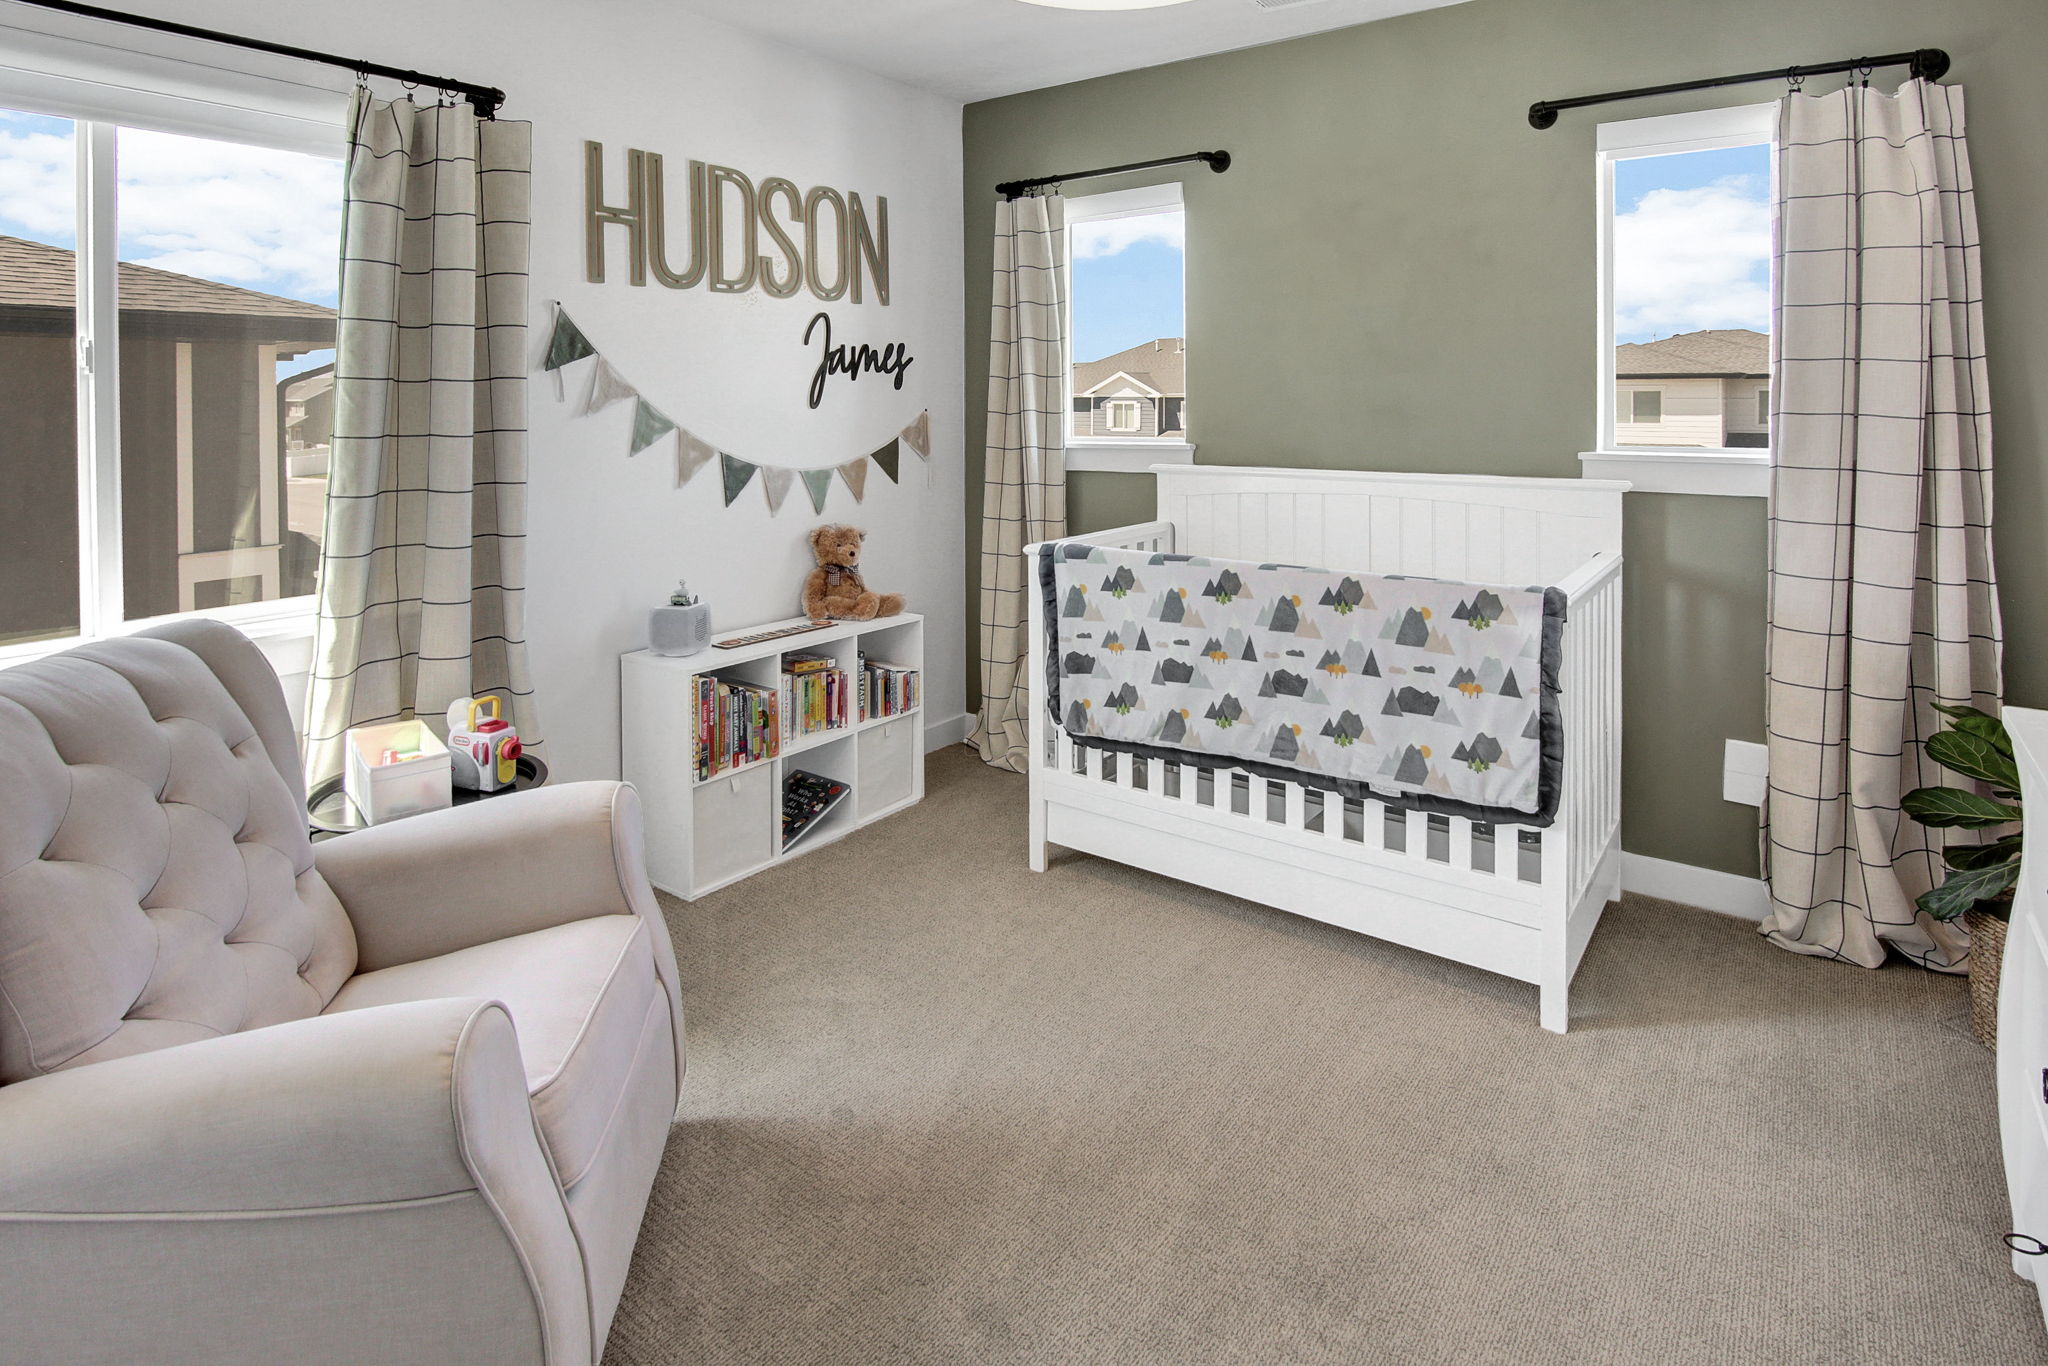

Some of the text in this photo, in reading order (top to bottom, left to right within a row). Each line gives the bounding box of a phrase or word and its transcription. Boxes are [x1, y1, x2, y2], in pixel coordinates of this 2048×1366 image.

[584, 139, 890, 307] HUDSON
[804, 312, 914, 410] James
[797, 788, 813, 797] Who
